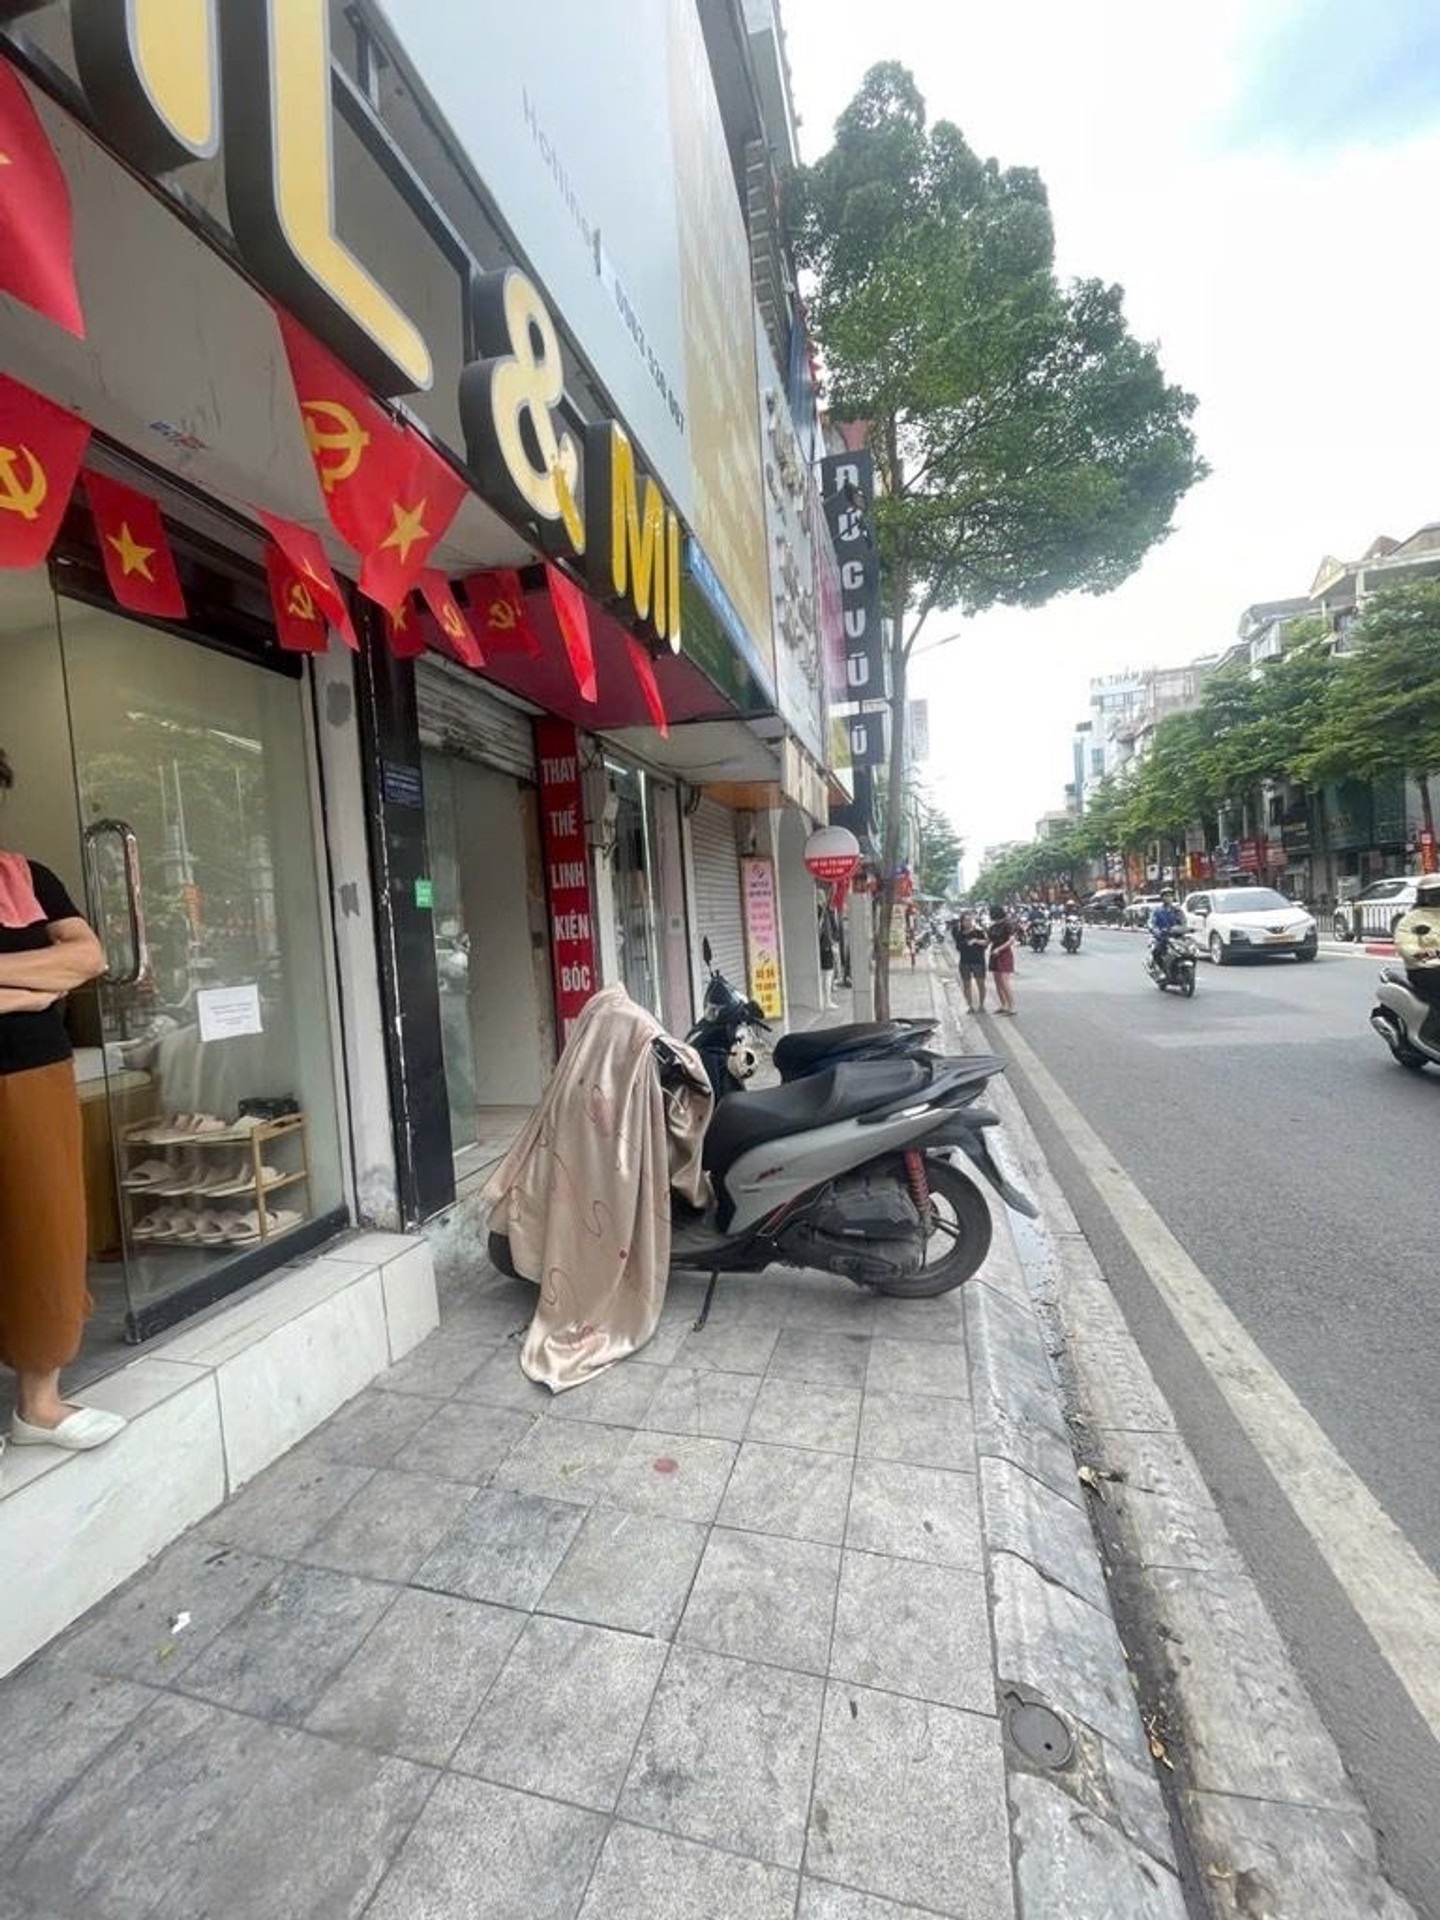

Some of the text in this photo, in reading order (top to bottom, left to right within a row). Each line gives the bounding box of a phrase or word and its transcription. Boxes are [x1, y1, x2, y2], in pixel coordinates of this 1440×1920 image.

[490, 265, 587, 556] &
[611, 418, 682, 655] MI
[541, 757, 577, 785] THAY
[550, 804, 578, 837] THẾ
[551, 861, 585, 890] LINH
[554, 908, 589, 945] KIỆN
